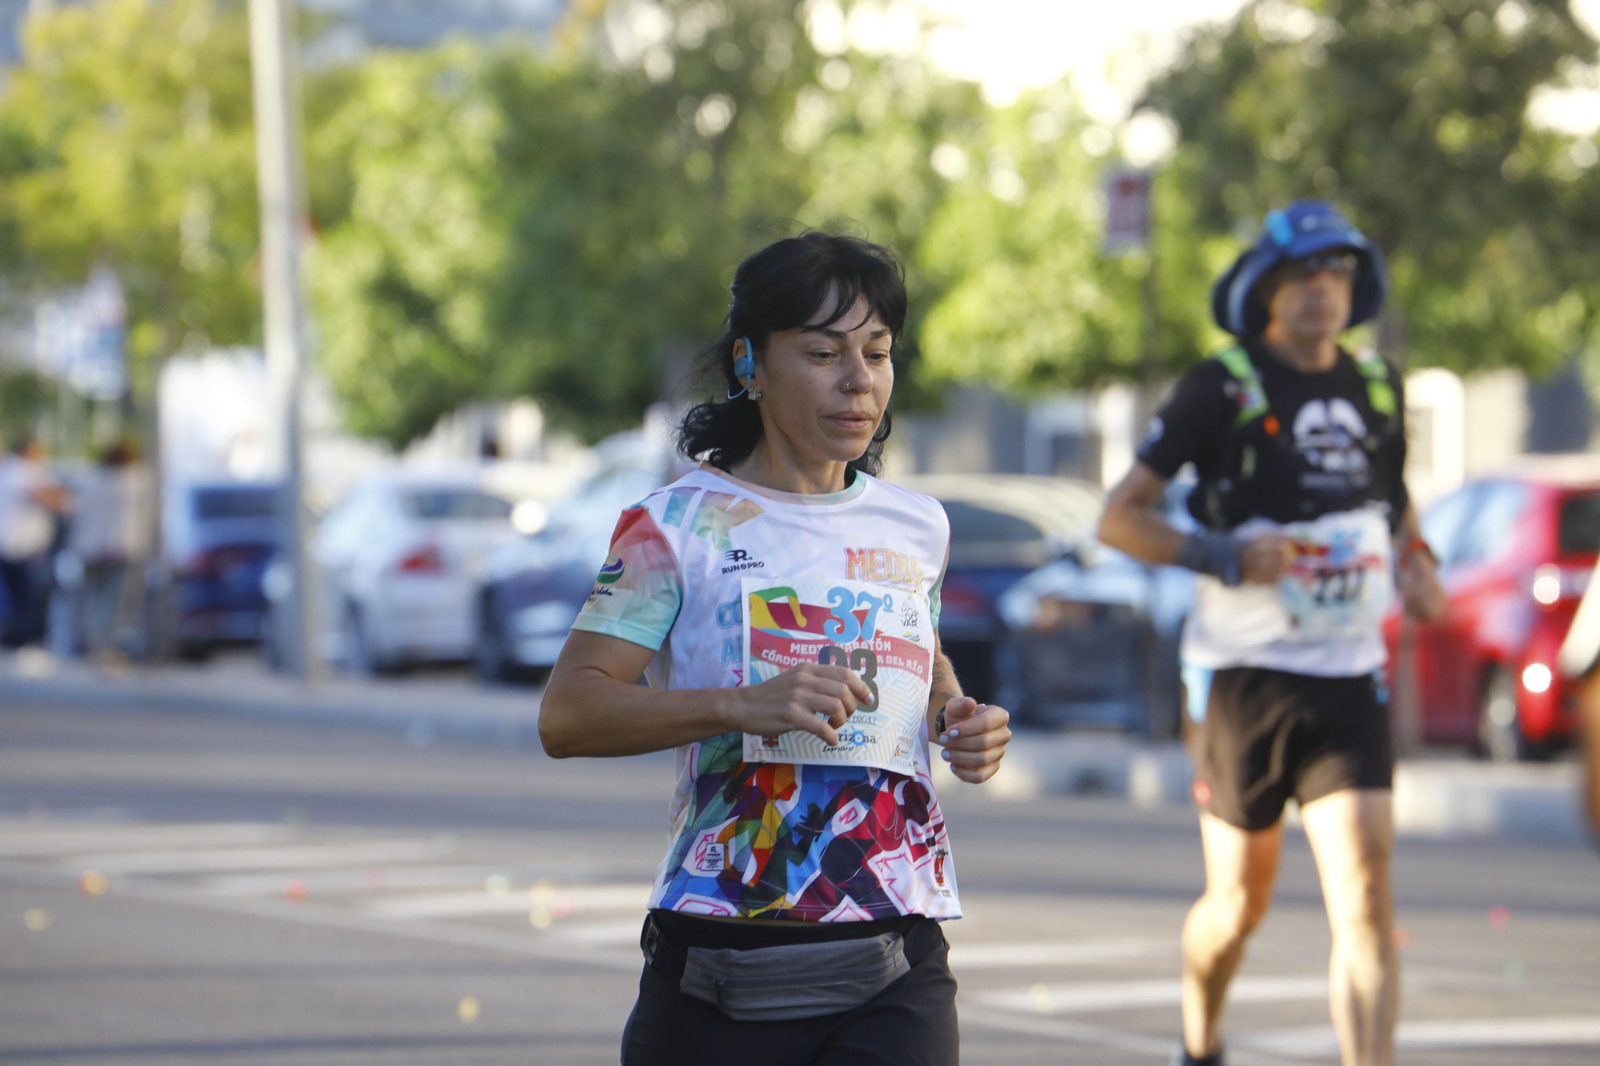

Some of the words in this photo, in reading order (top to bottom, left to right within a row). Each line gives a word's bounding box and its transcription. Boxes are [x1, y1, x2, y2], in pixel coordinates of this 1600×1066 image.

[844, 546, 925, 590] MEDIA
[818, 645, 880, 713] 3
[885, 655, 905, 667] DEL
[906, 659, 923, 674] RÍO
